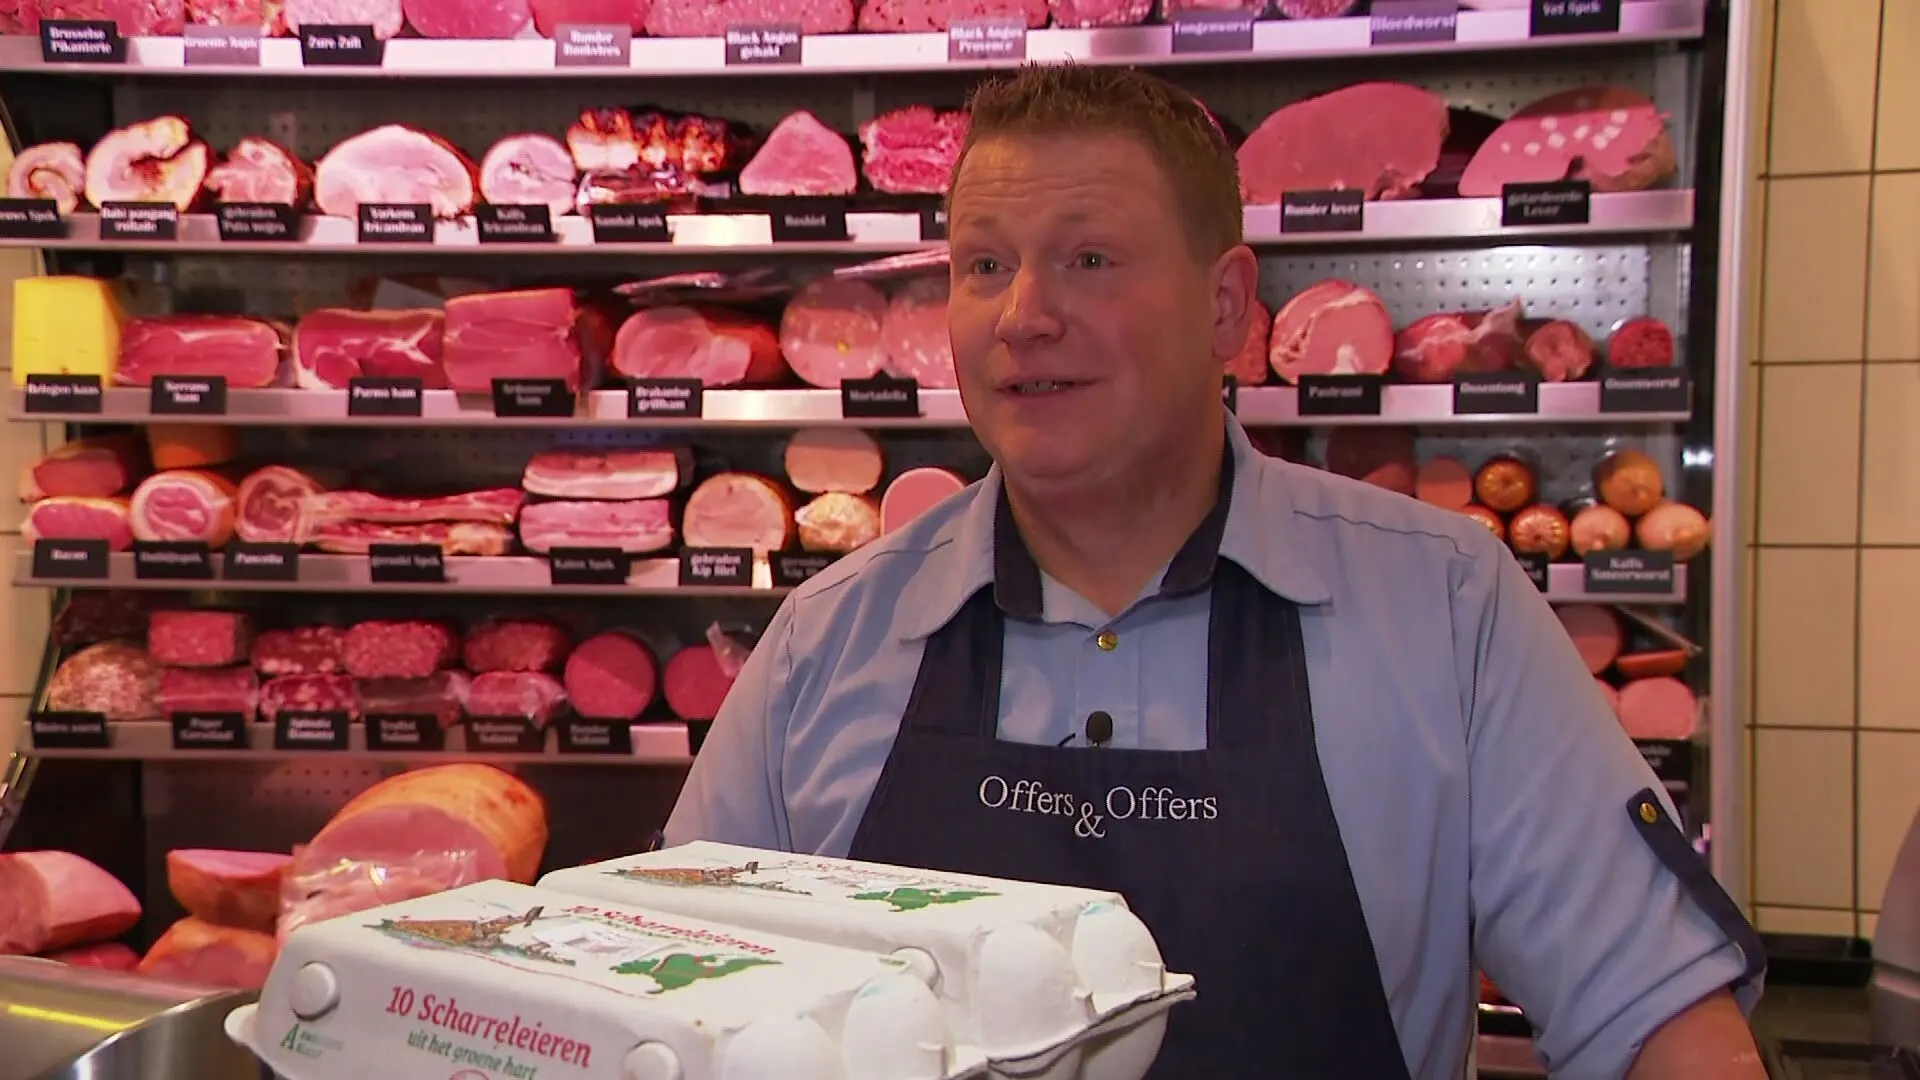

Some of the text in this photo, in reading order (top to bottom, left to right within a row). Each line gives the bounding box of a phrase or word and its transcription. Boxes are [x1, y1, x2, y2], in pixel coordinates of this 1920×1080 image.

[1284, 203, 1328, 217] Runder
[172, 391, 200, 402] ham
[352, 385, 417, 399] Parma ham
[979, 775, 1218, 838] Offers & Offers
[385, 986, 592, 1068] 10 Scharreleieren
[407, 1029, 538, 1080] uit het groene hart
